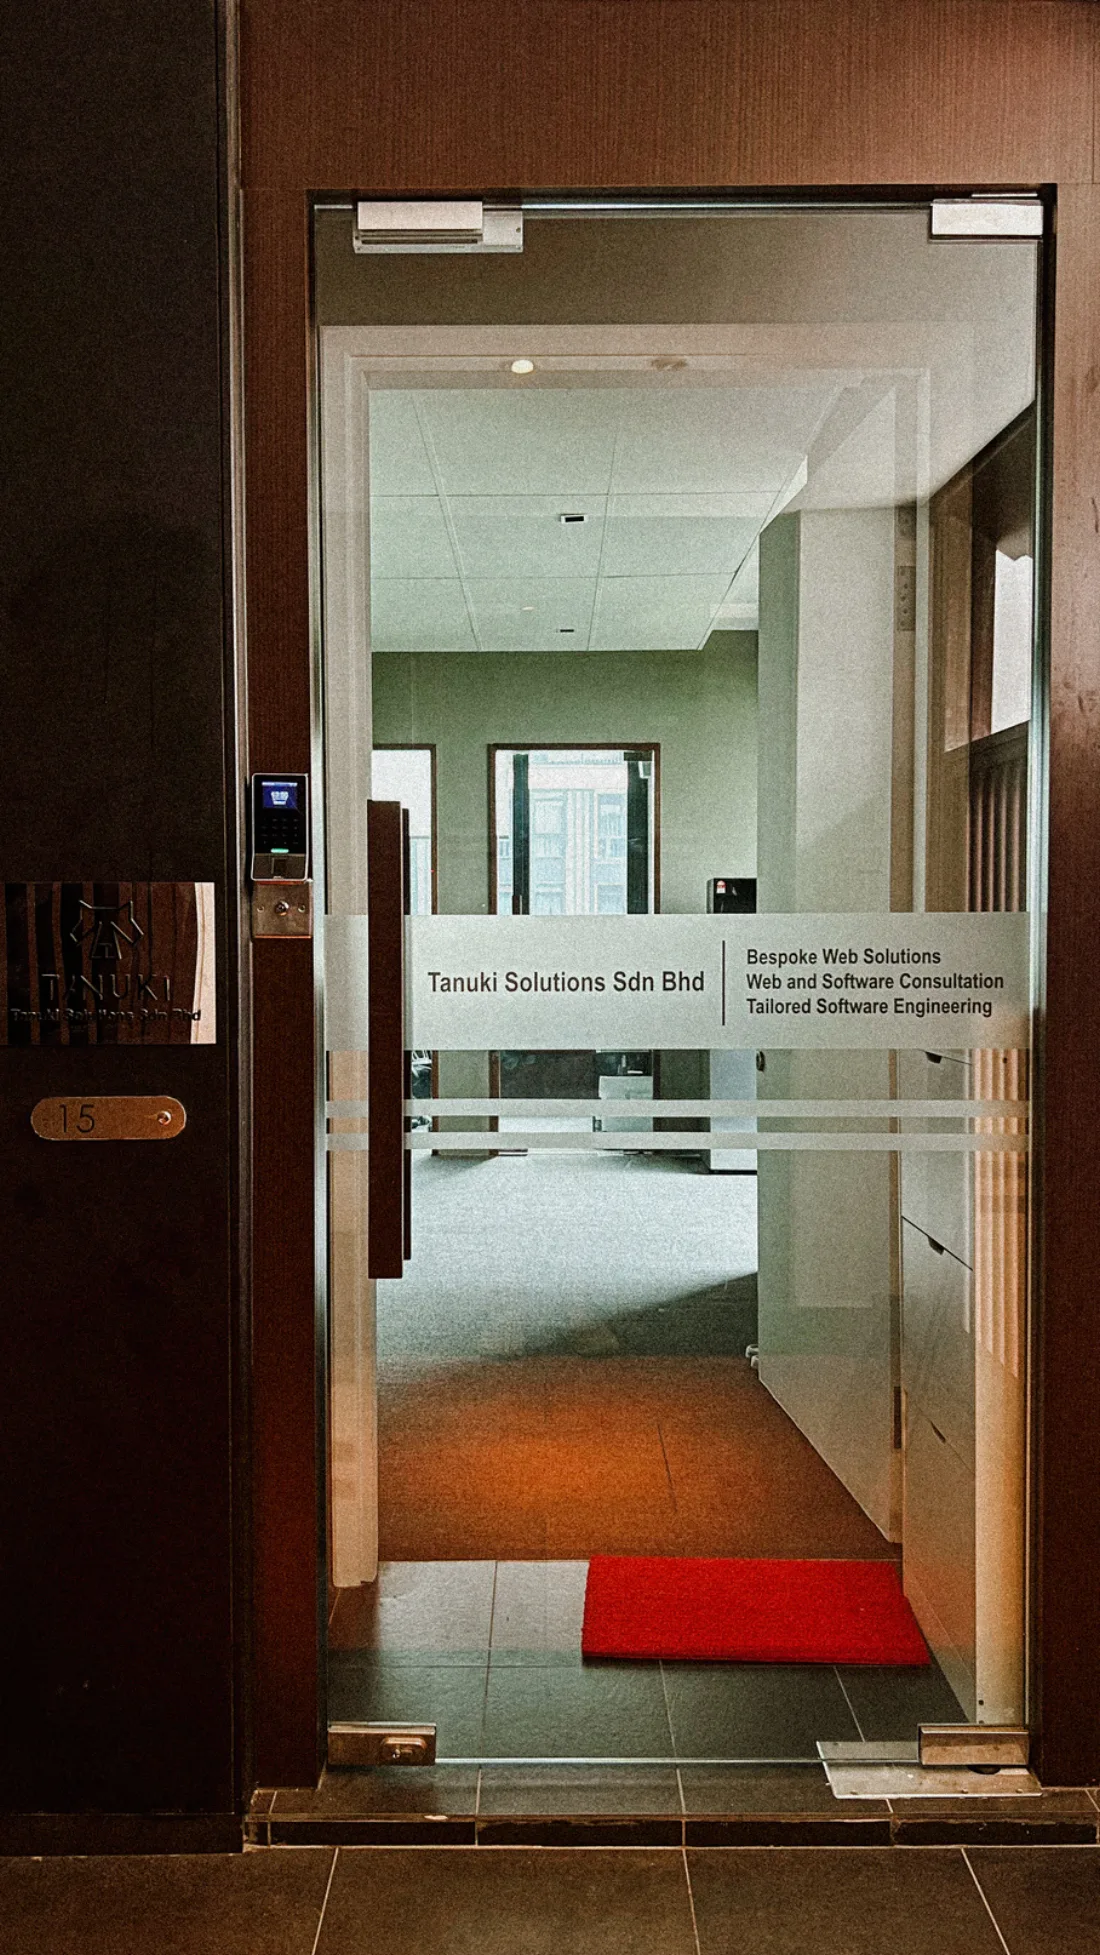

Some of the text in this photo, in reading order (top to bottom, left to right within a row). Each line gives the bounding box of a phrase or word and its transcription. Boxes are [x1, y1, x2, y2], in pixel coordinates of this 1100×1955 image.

[747, 947, 941, 969] Bespoke Web Solutions
[41, 973, 172, 1001] TANUKI
[427, 970, 704, 992] Tanuki Solutions Sdn Bhd
[746, 972, 1005, 990] Web and Software Consultation
[746, 997, 993, 1018] Tailored Software Engineering
[59, 1104, 96, 1134] 15
